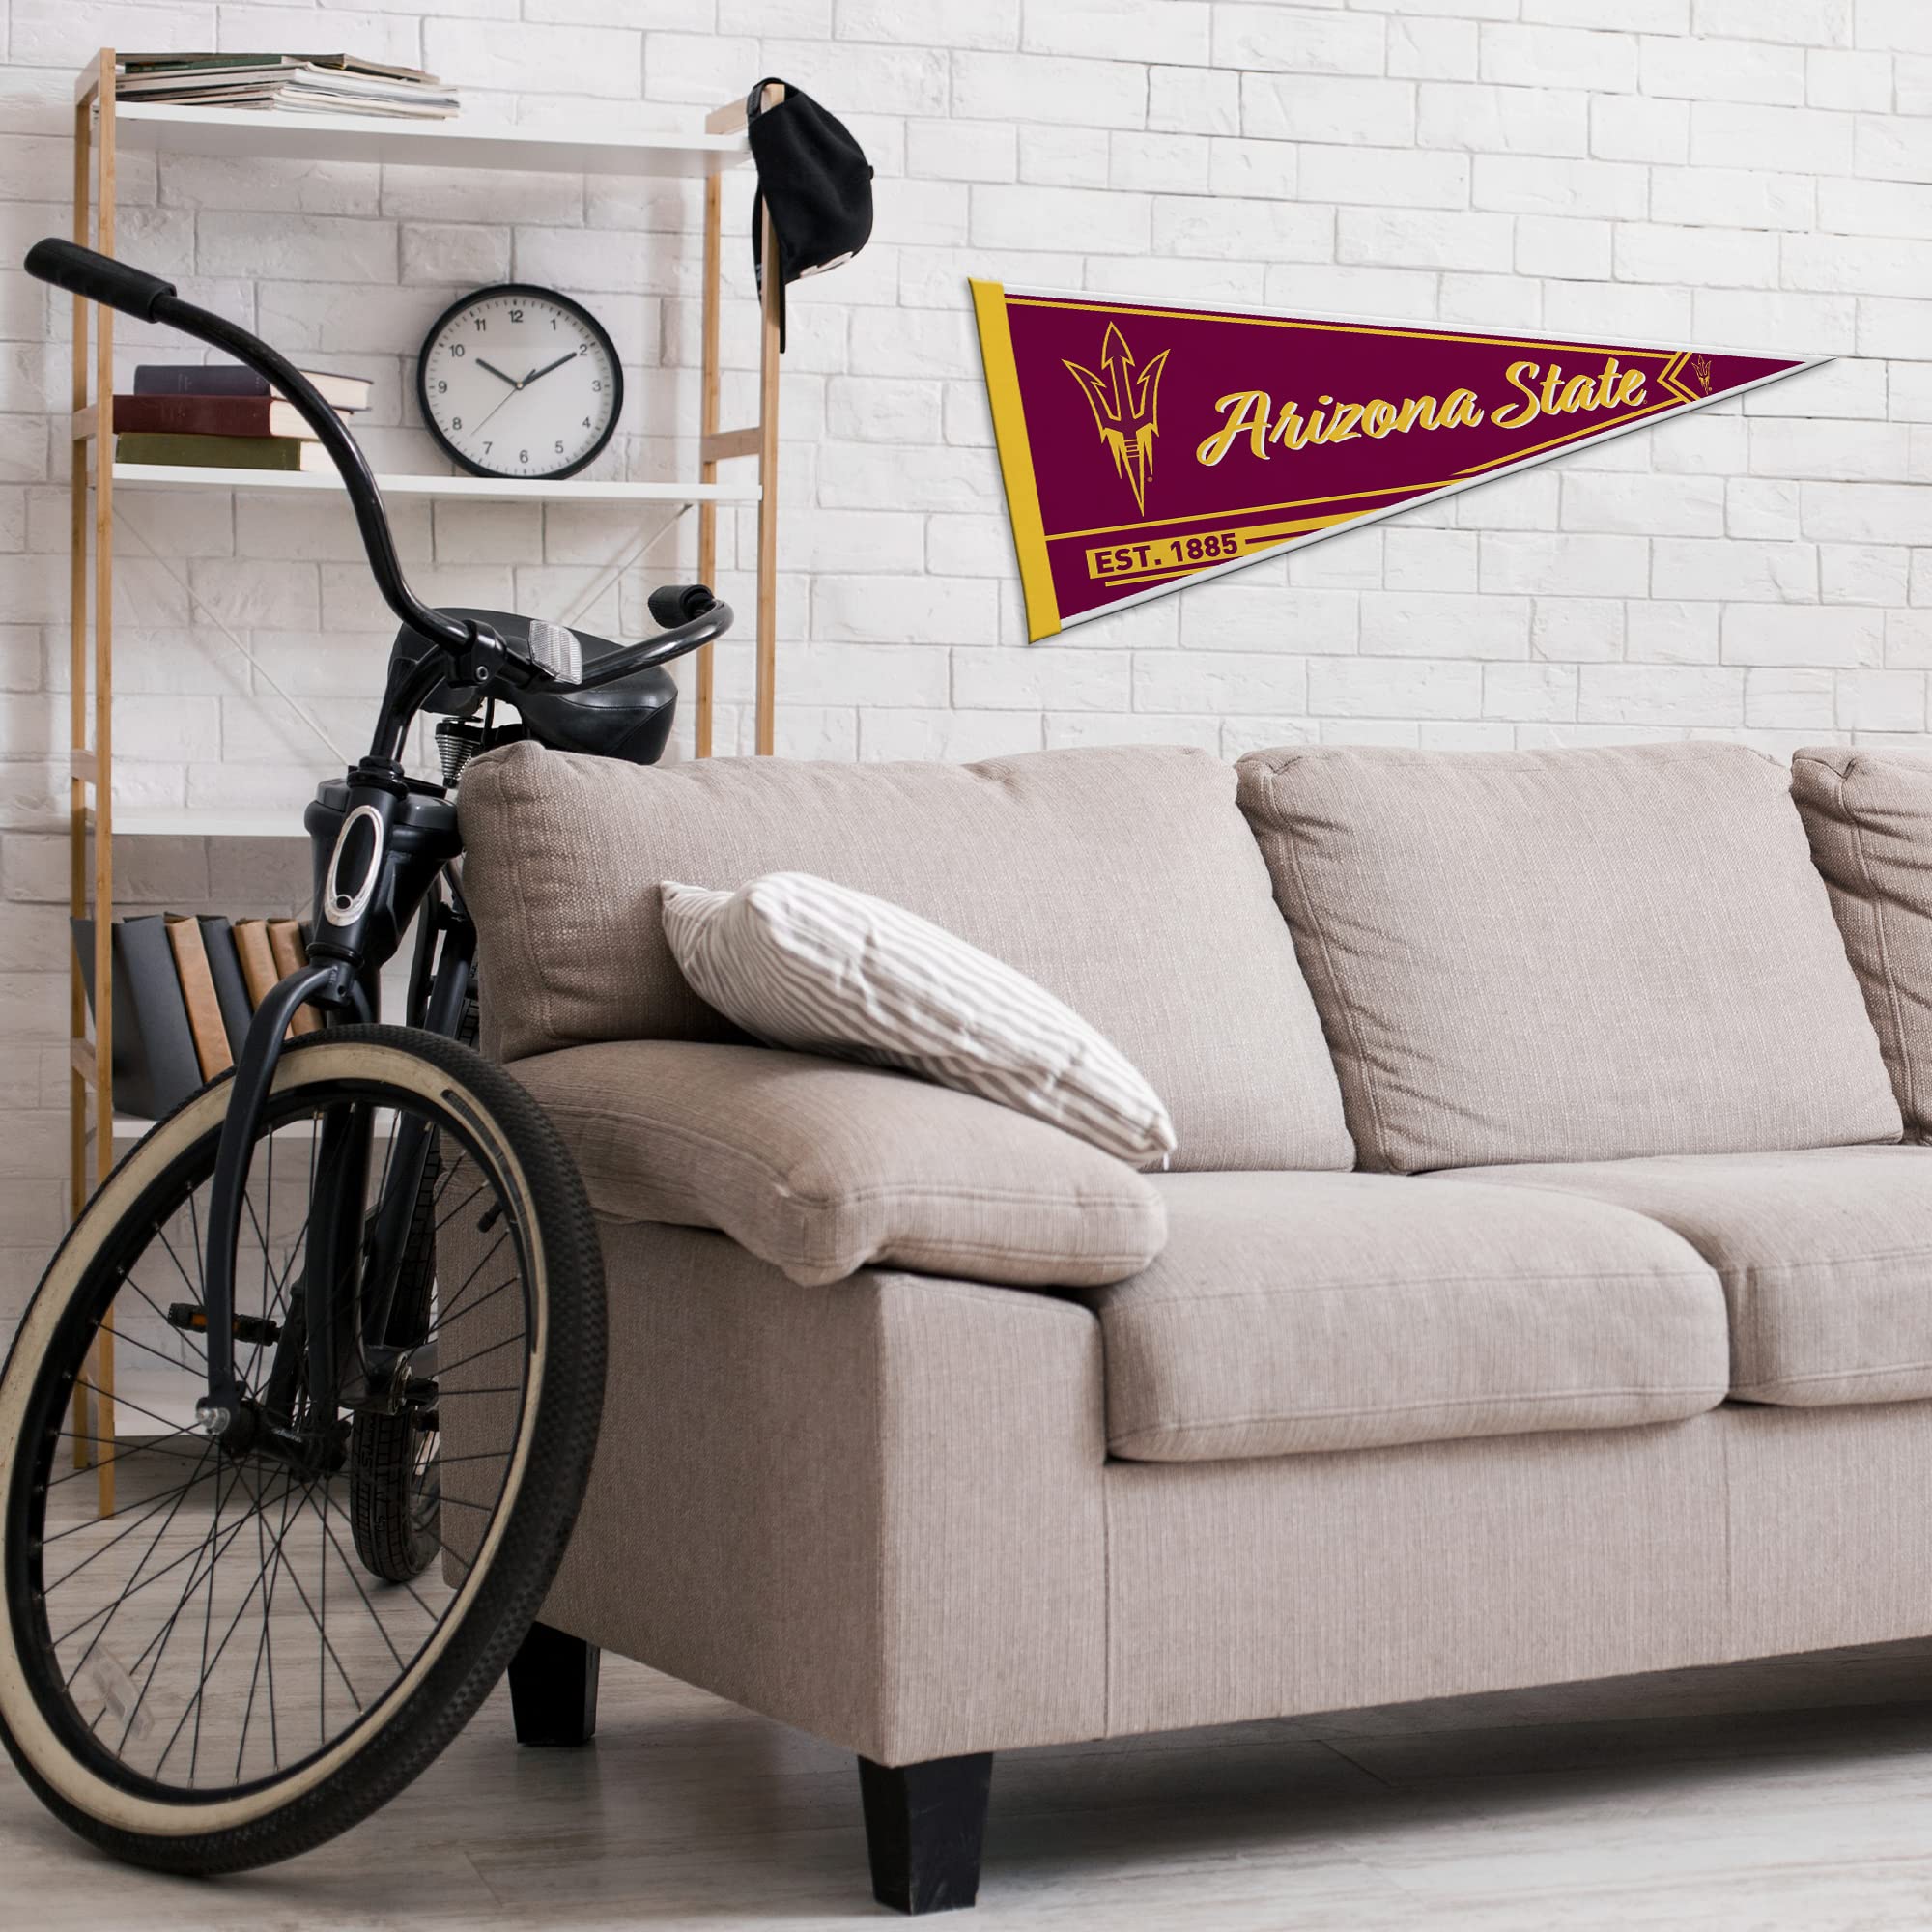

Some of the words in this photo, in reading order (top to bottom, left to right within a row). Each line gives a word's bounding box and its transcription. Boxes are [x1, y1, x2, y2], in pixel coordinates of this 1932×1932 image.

[508, 309, 524, 324] 12
[473, 318, 487, 332] 11
[550, 318, 557, 331] 1
[448, 343, 466, 357] 10
[579, 343, 588, 356] 2
[438, 380, 448, 394] 9
[591, 380, 602, 391] 3
[1196, 390, 1484, 466] Arizona
[1491, 357, 1646, 429] State
[452, 416, 463, 431] 8
[582, 416, 591, 428] 4
[483, 441, 493, 455] 7
[554, 440, 564, 454] 5
[519, 449, 529, 464] 6
[1095, 545, 1162, 574] EST.
[1171, 533, 1237, 562] 1885
